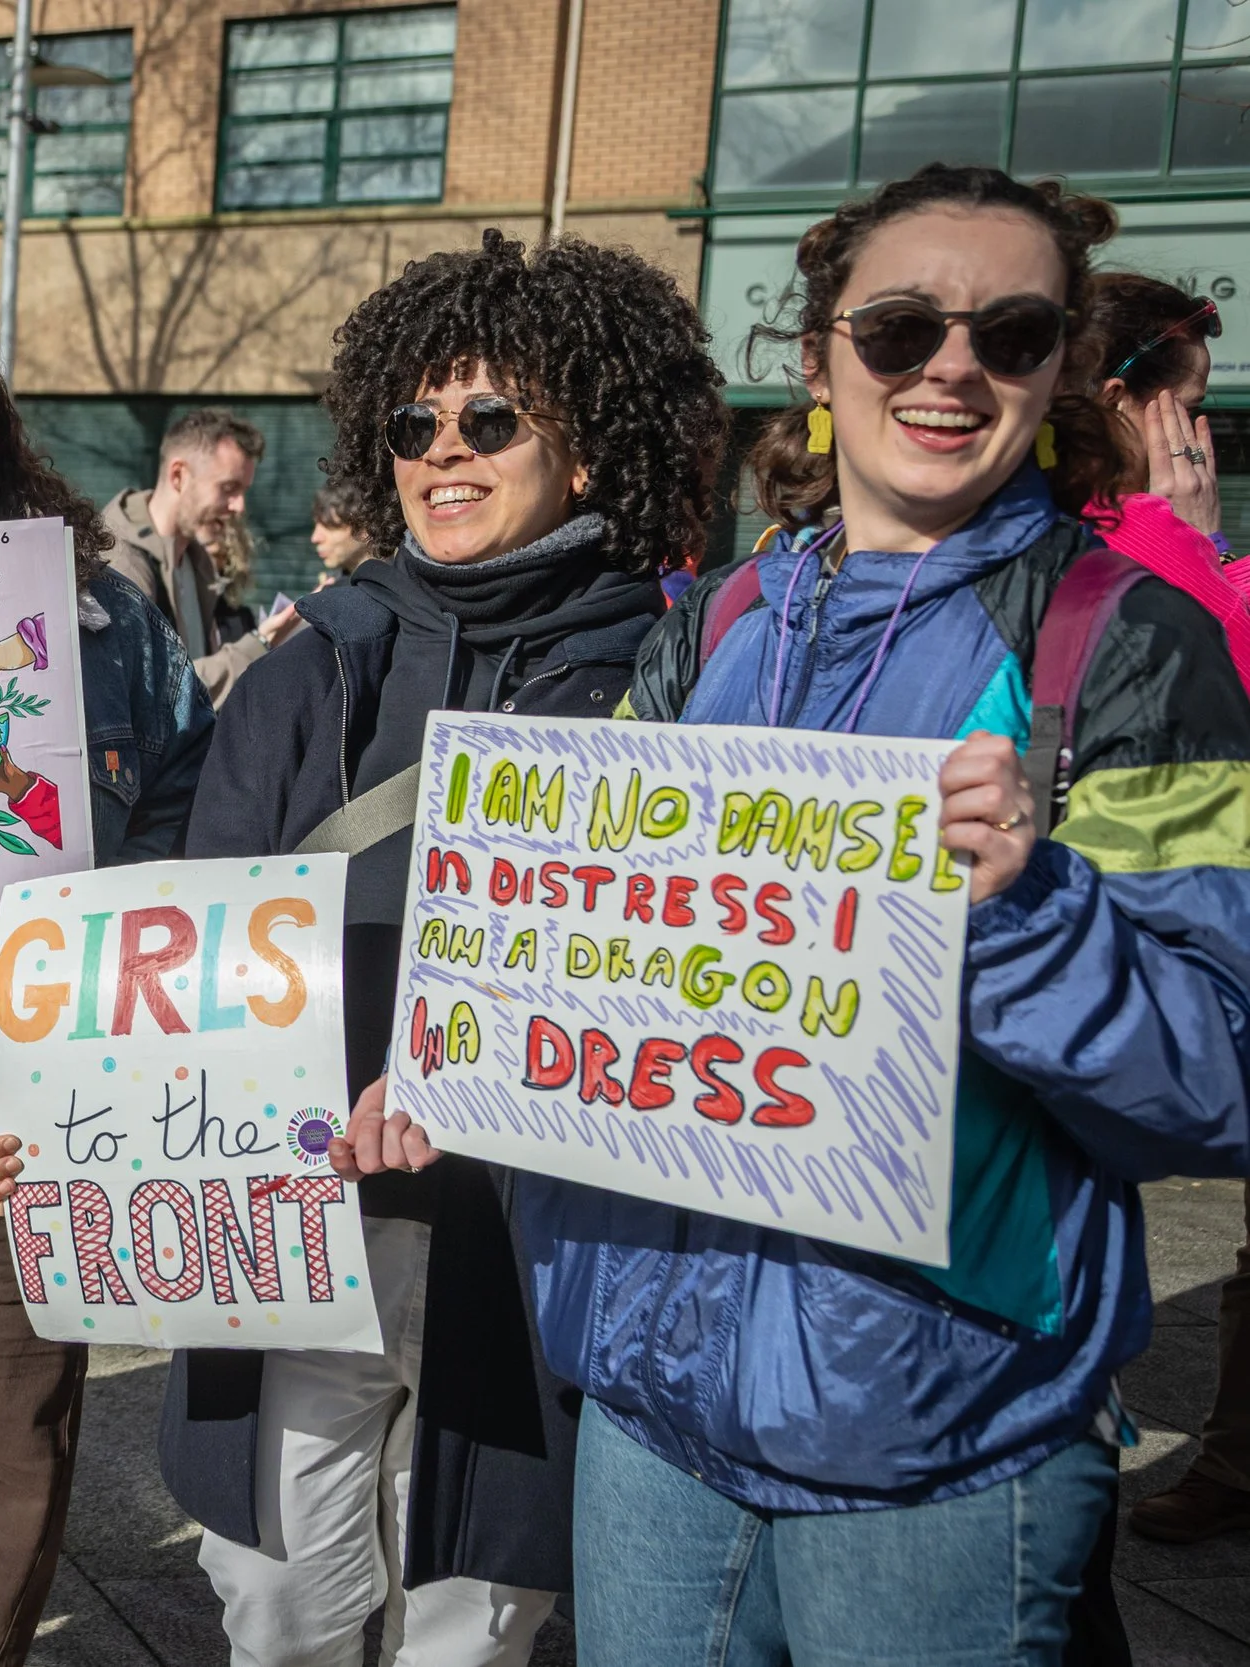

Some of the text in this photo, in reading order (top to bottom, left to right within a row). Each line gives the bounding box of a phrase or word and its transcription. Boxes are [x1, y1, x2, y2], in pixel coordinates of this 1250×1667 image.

[446, 752, 964, 895] I AM NO DAMSEL
[418, 918, 860, 1039] AM A DRAGON
[834, 886, 857, 954] I
[54, 1068, 280, 1165] to the
[446, 1001, 481, 1065] A
[521, 1015, 817, 1128] DRESS
[9, 1174, 345, 1306] FRONT
